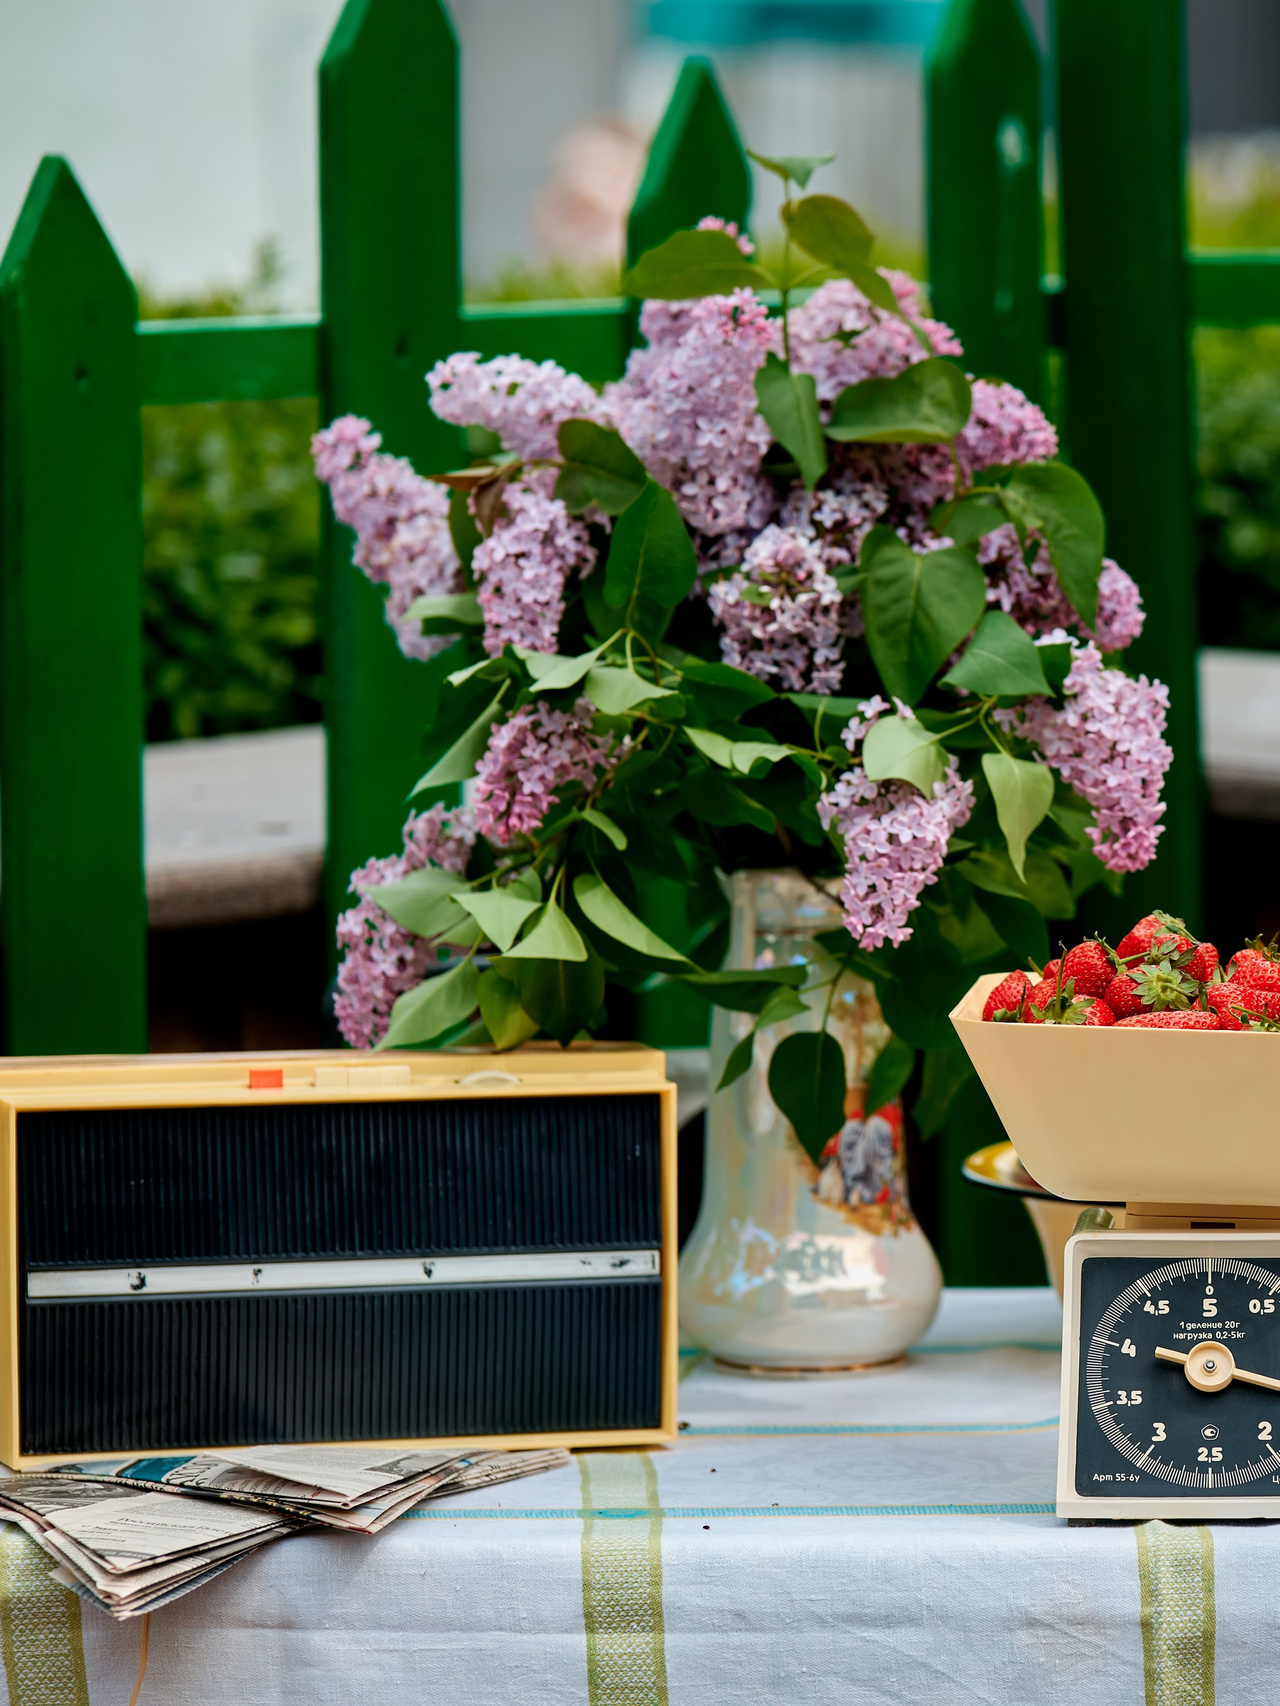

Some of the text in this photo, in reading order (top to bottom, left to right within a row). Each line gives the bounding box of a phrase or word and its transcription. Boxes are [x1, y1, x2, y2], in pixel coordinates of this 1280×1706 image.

[1205, 1285, 1214, 1296] 0
[1143, 1299, 1170, 1316] 4,5
[1202, 1298, 1218, 1318] 5
[1248, 1299, 1276, 1316] 0,5
[1186, 1322, 1223, 1331] деление
[1224, 1320, 1241, 1329] 20г
[1172, 1332, 1213, 1340] нагрузка
[1120, 1338, 1137, 1358] 4
[1115, 1390, 1143, 1407] 3,5
[1151, 1422, 1167, 1442] 3
[1257, 1421, 1273, 1440] 2
[1196, 1447, 1224, 1464] 2,5
